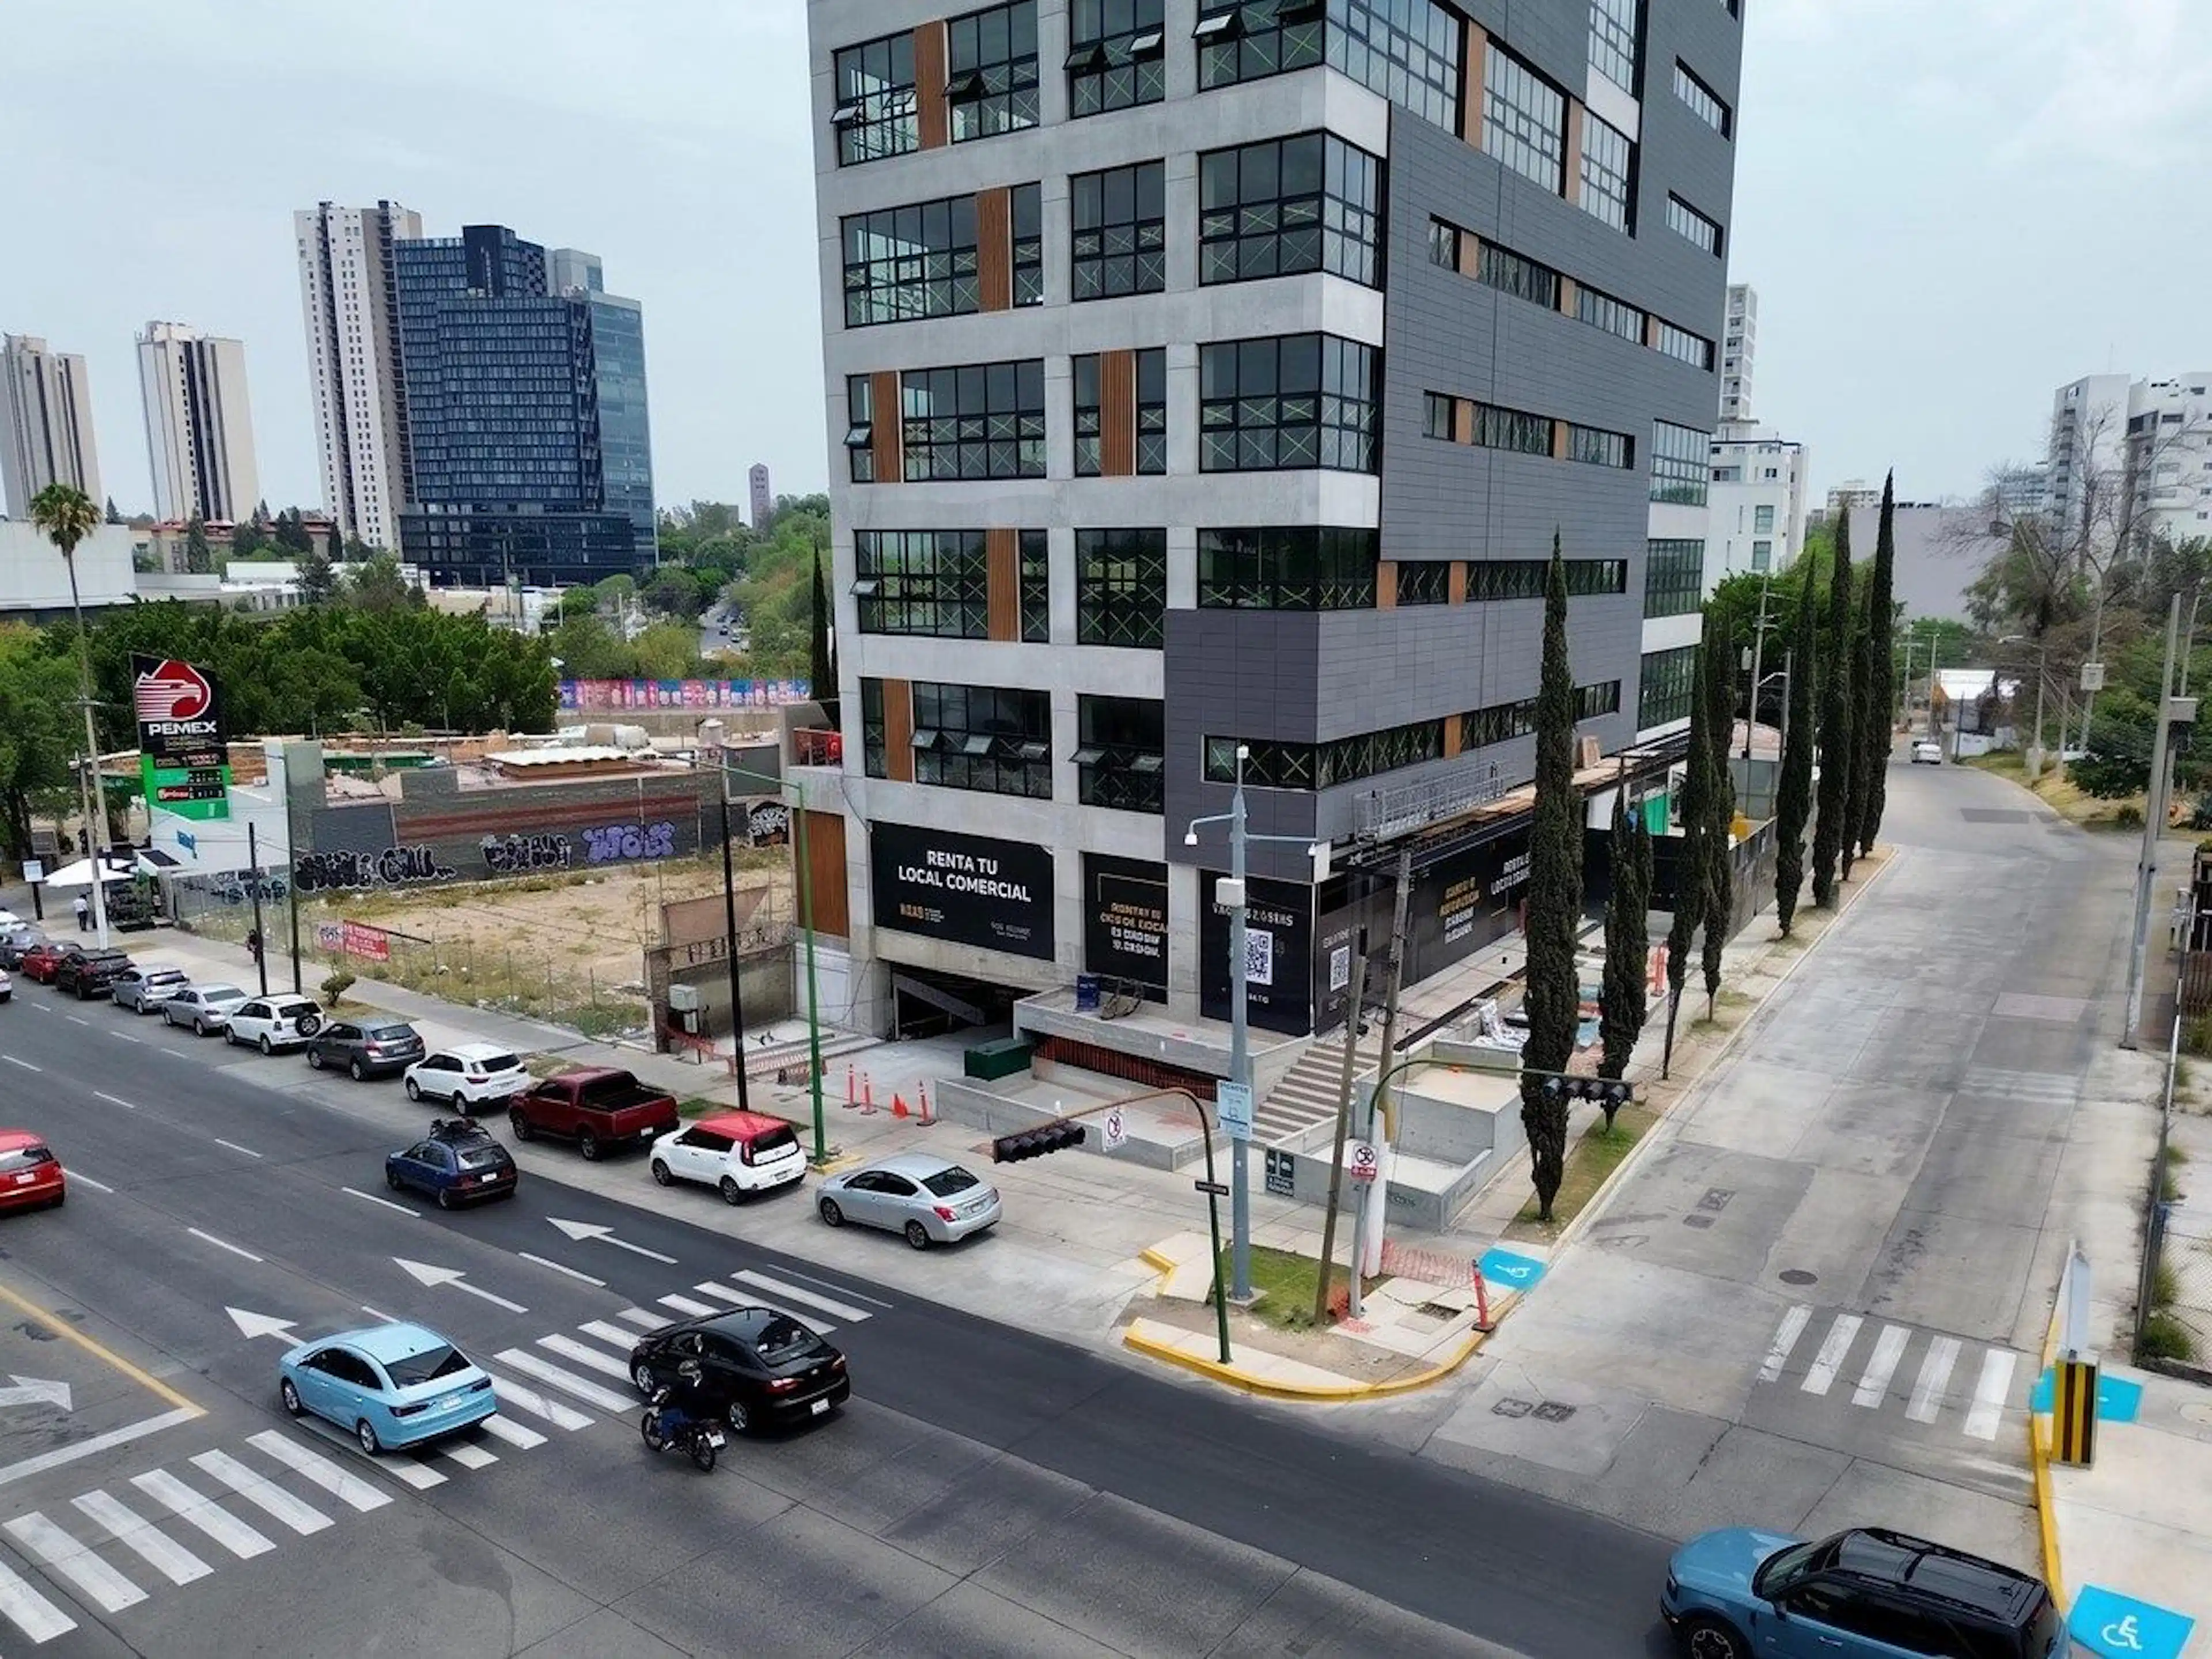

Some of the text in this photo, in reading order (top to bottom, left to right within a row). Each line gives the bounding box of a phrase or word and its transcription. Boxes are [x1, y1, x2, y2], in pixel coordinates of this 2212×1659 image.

[148, 720, 217, 736] PEMEX
[926, 850, 998, 875] RENTA TU
[898, 865, 1032, 903] LOCAL COMERCIAL
